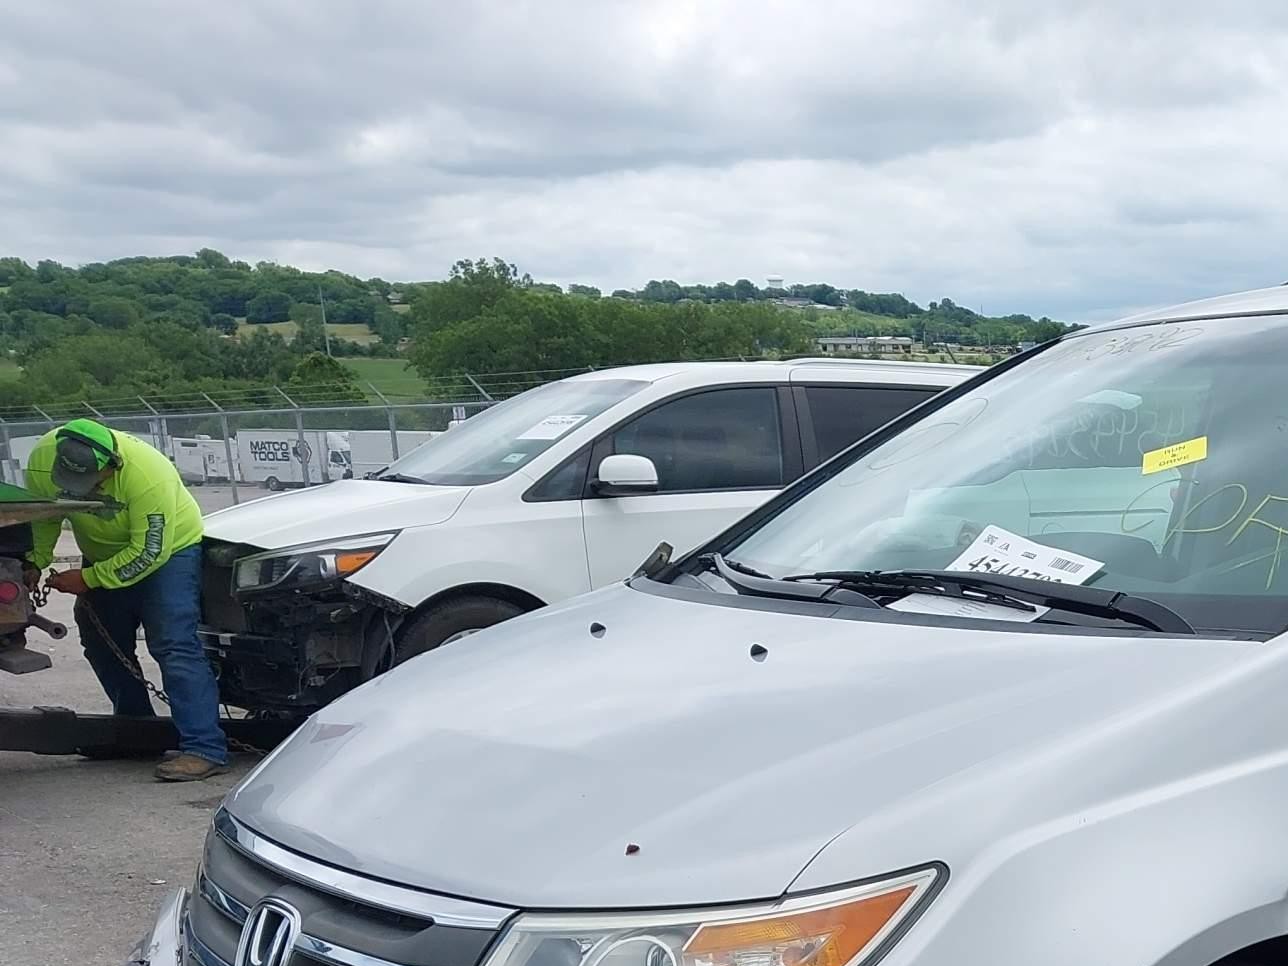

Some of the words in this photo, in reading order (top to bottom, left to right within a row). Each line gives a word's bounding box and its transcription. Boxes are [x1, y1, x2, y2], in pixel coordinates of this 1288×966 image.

[249, 440, 289, 452] MATCO
[251, 450, 290, 462] TOOLS
[1158, 454, 1190, 467] DRIVE
